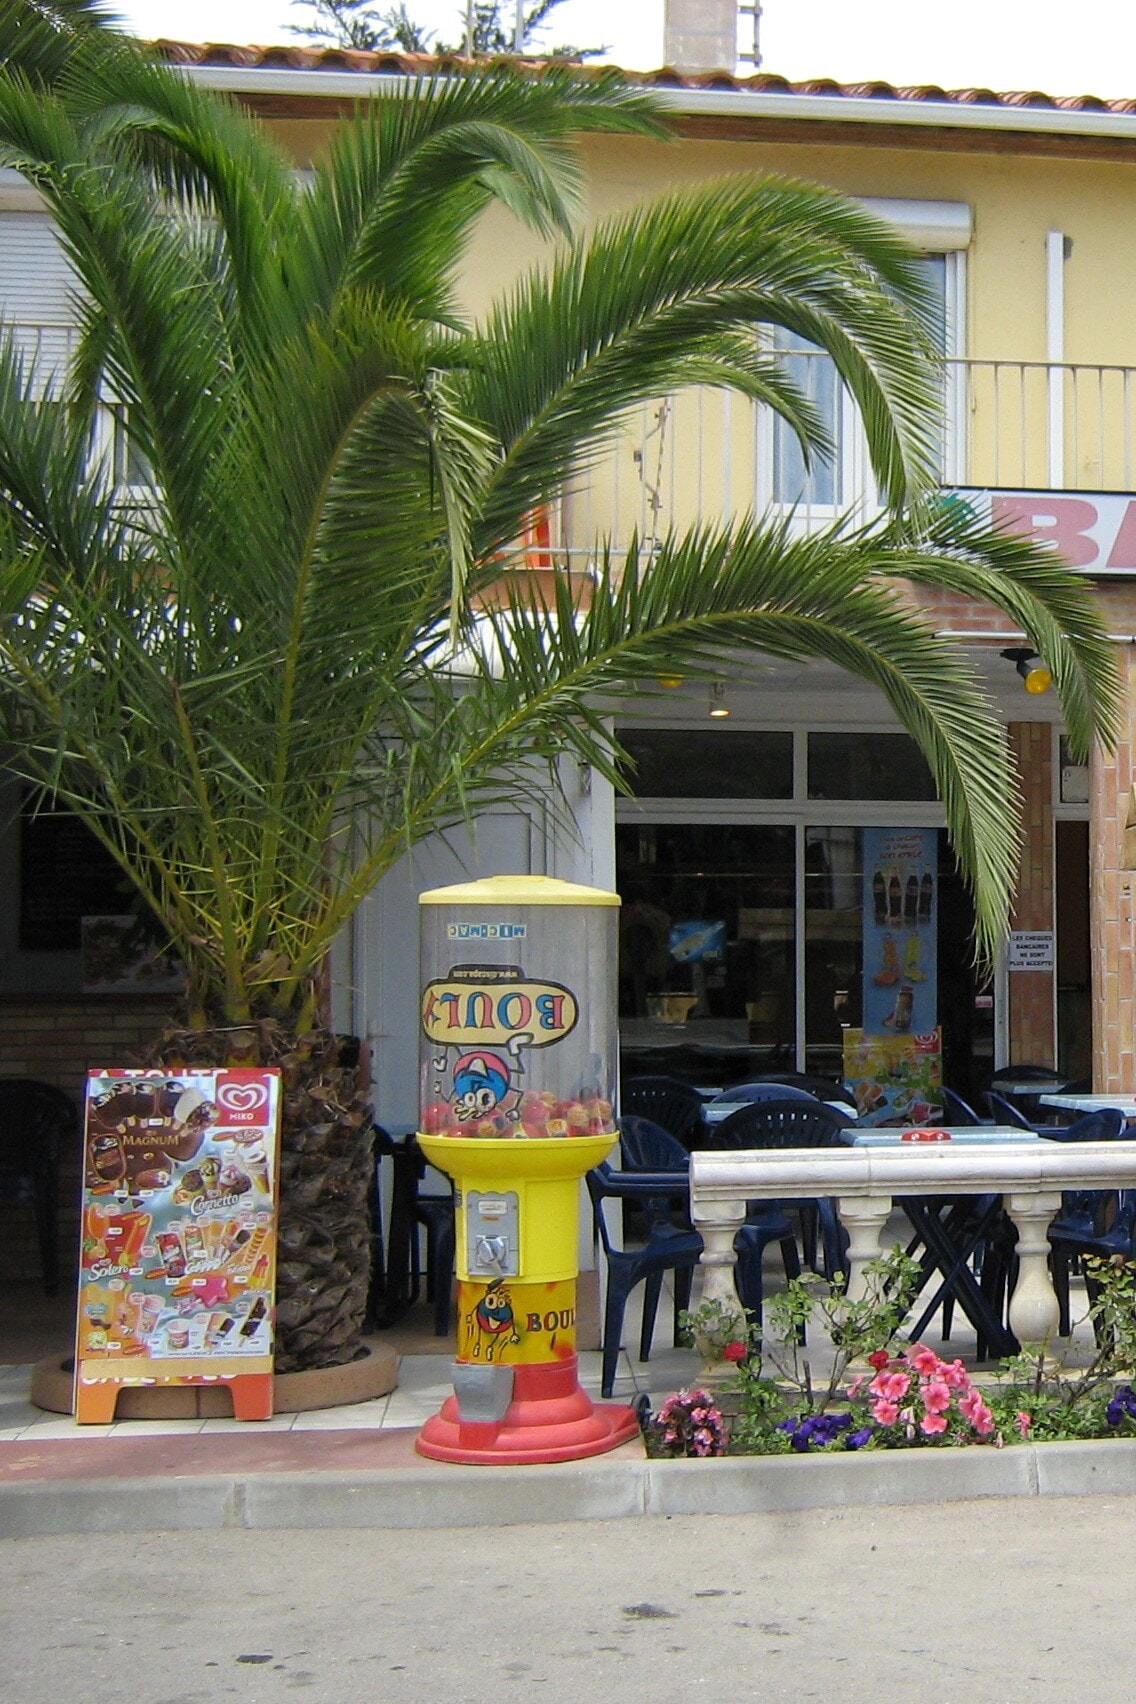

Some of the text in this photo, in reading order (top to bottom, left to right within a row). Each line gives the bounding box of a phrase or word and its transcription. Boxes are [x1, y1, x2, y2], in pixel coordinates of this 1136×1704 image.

[422, 990, 565, 1030] BOULY
[229, 1112, 254, 1121] MIKO
[122, 1135, 180, 1146] MAGNUM
[190, 1193, 239, 1216] Cornetto
